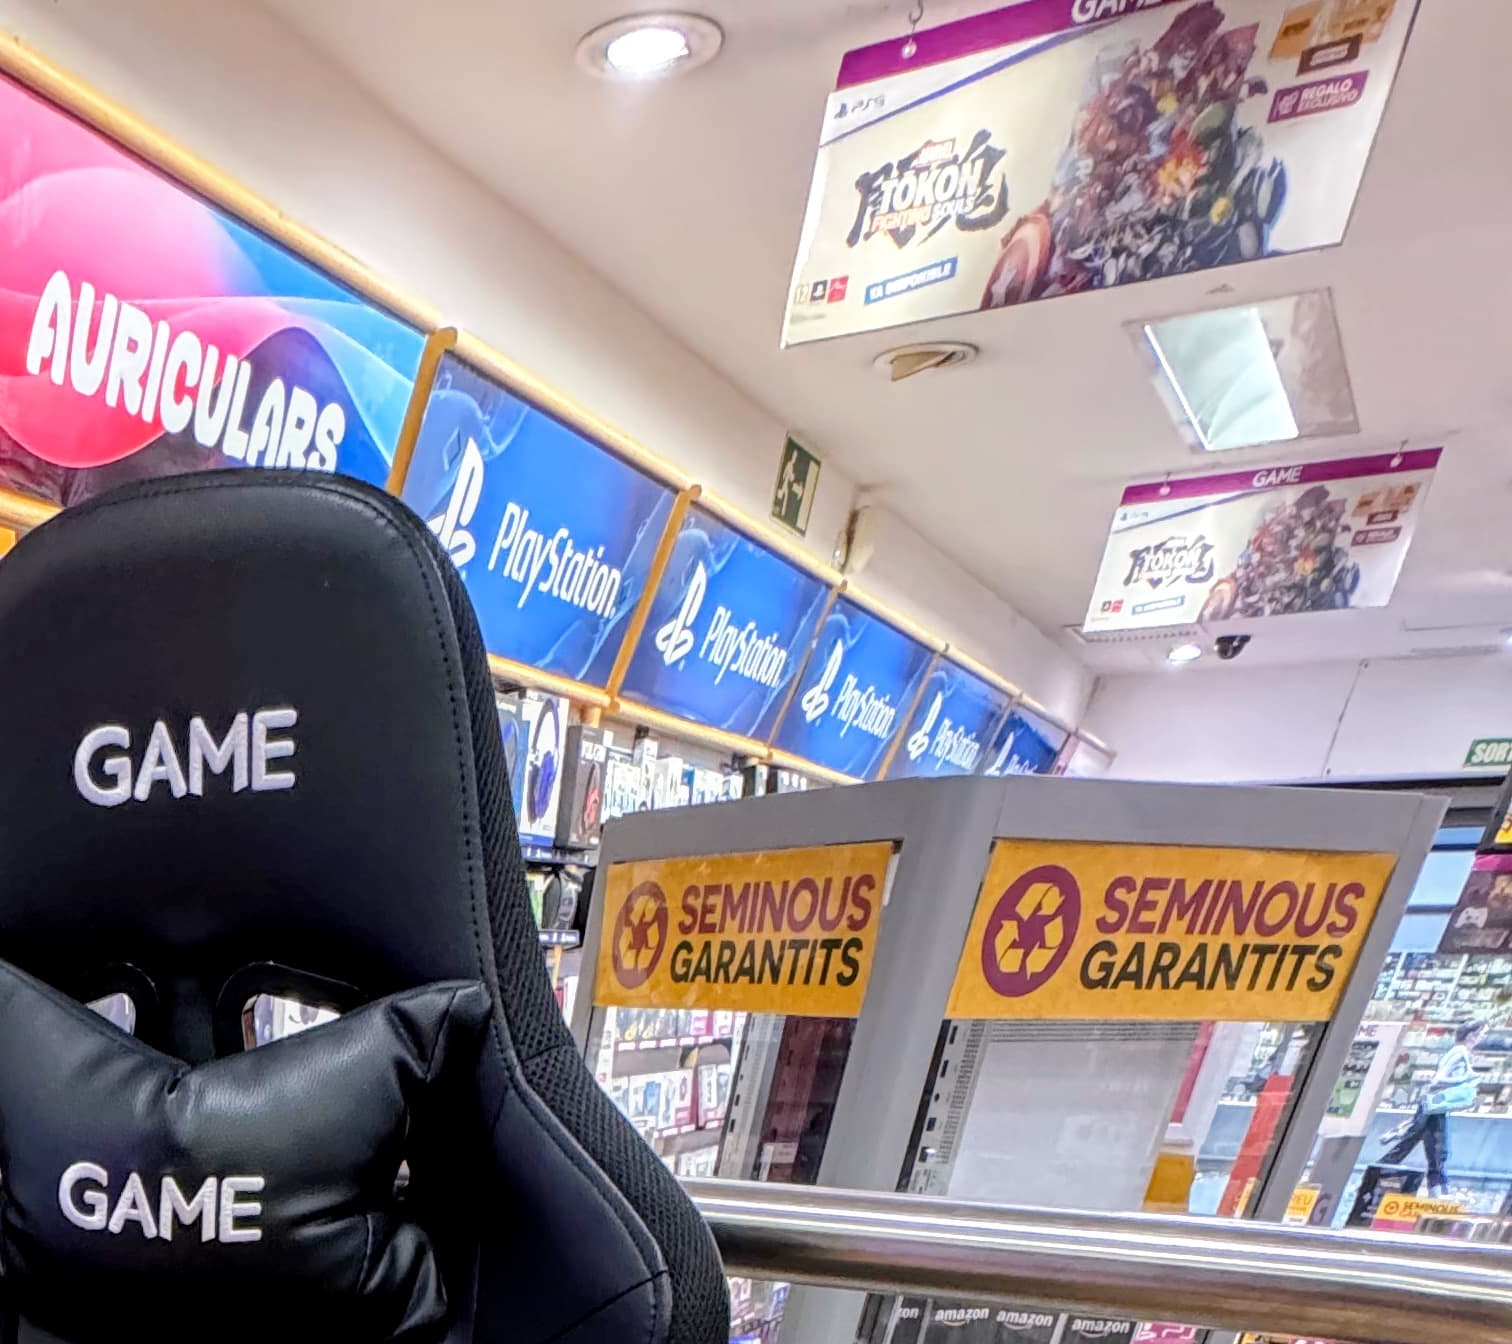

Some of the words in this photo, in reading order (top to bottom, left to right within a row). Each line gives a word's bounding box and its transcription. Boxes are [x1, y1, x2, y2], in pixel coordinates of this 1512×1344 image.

[25, 270, 346, 473] AURICULARS
[1252, 465, 1304, 489] GAME
[488, 502, 623, 620] PlayStation
[698, 604, 787, 688] PlayStation
[830, 673, 897, 740] PlayStation
[74, 708, 298, 808] GAME
[677, 873, 877, 935] SEMINOUS
[1095, 875, 1366, 937] SEMINOUS
[669, 936, 864, 988] GARANTITS
[1079, 939, 1344, 993] GARANTITS
[58, 1161, 266, 1243] GAME
[934, 1305, 990, 1323] amazon
[996, 1308, 1054, 1329] amazon
[1071, 1315, 1131, 1336] amazon
